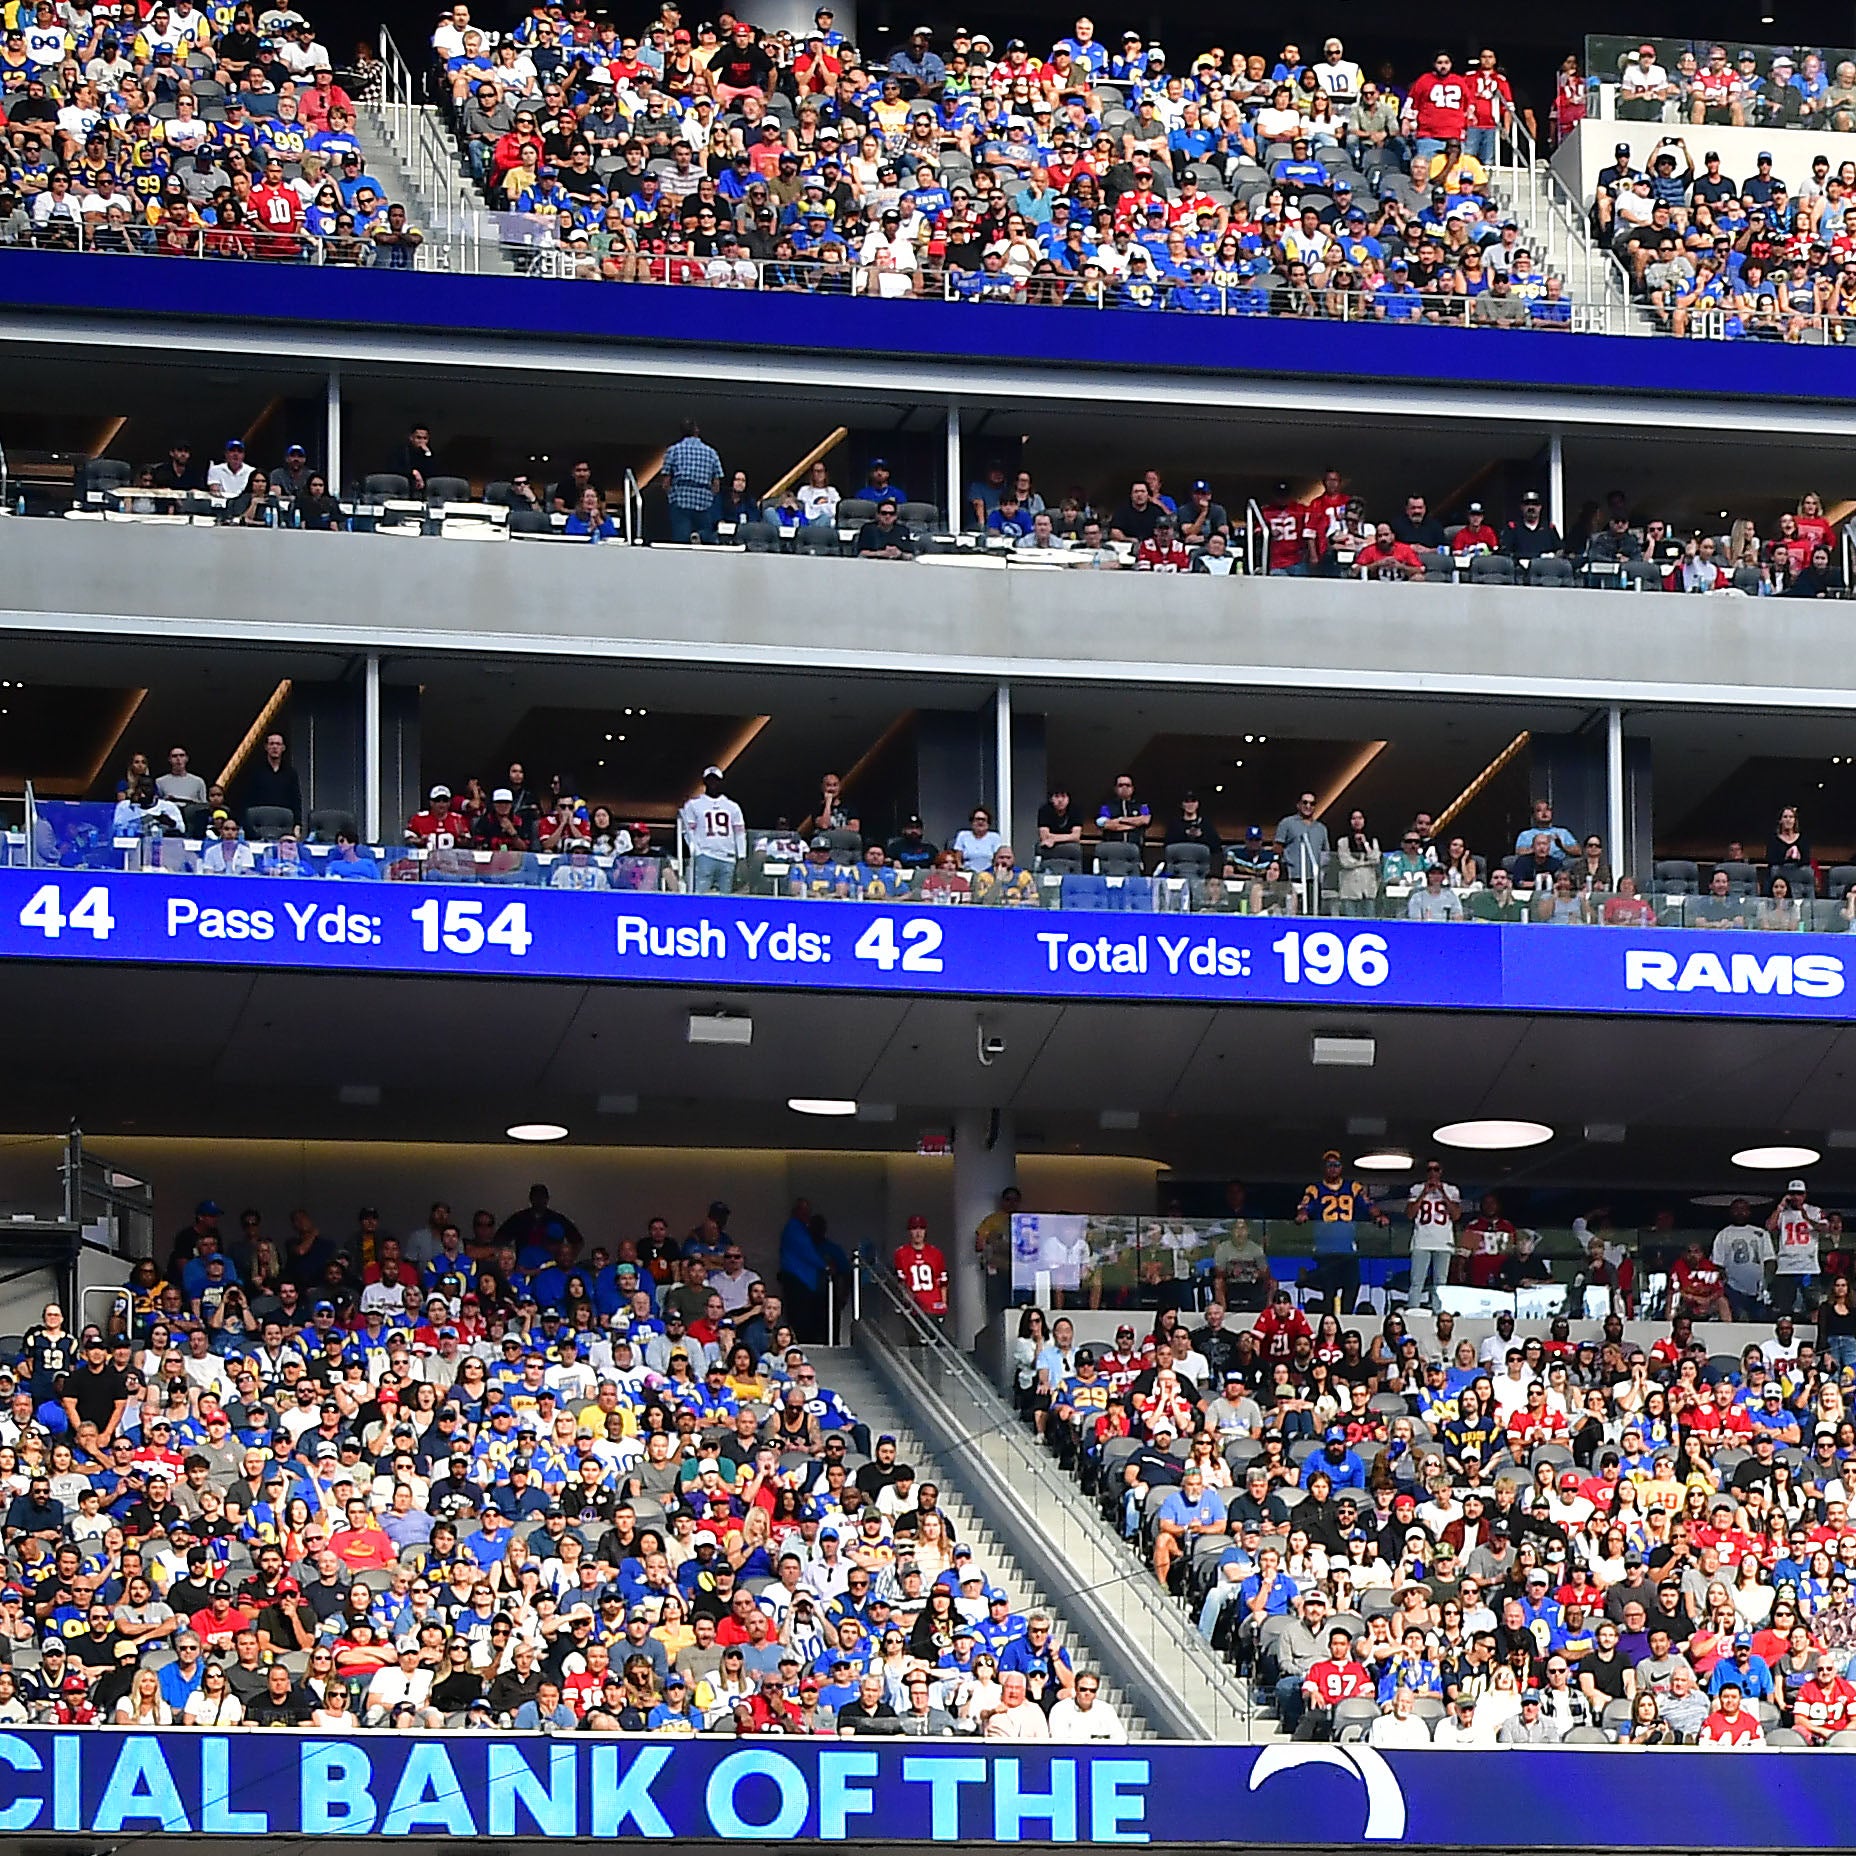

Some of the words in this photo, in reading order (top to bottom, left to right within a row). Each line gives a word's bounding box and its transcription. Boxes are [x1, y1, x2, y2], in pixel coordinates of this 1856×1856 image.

[1430, 85, 1461, 109] 42
[706, 812, 731, 837] 19
[20, 885, 114, 939] 44
[168, 898, 274, 939] Pass
[284, 903, 380, 944] Yds:
[412, 900, 532, 955] 154
[618, 916, 725, 958] Rush
[736, 921, 830, 962] Yds:
[855, 918, 942, 972] 42
[1037, 933, 1146, 973] Total
[1157, 937, 1250, 976] Yds:
[1273, 932, 1388, 986] 196
[1626, 951, 1844, 997] RAMS
[1321, 1196, 1353, 1222] 29
[1328, 1676, 1358, 1697] 97
[302, 1742, 675, 1839] BANK
[706, 1750, 878, 1842] OF
[899, 1757, 1150, 1844] THE
